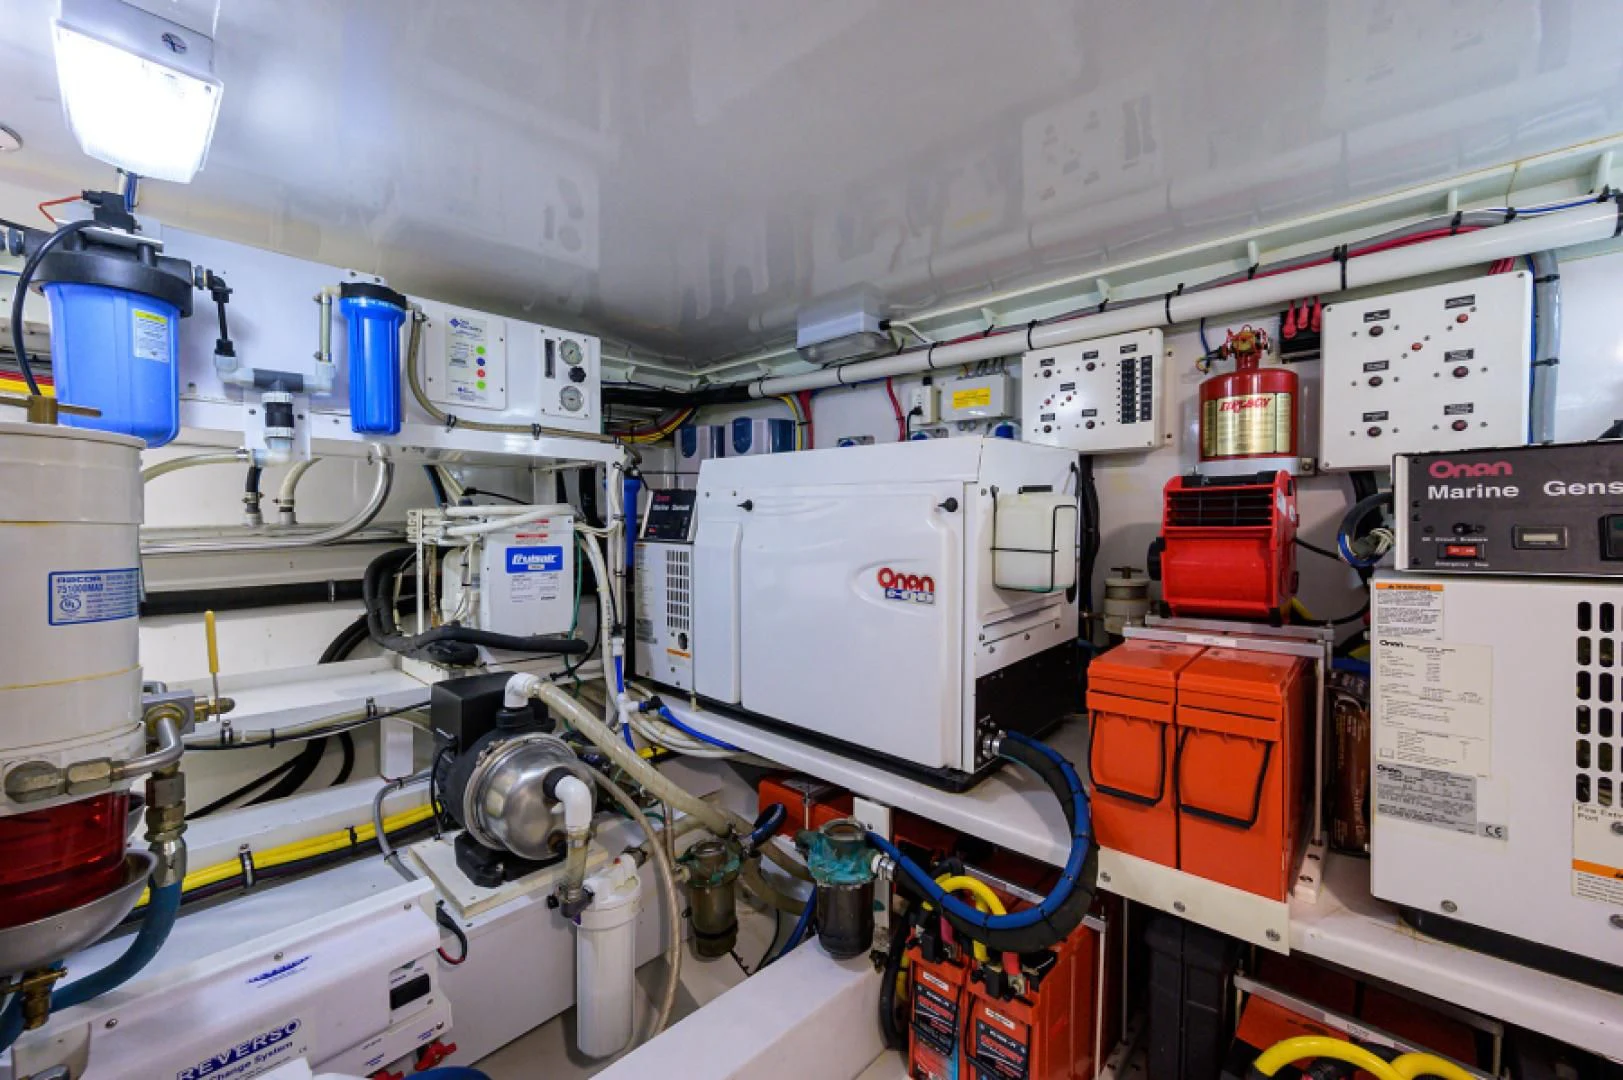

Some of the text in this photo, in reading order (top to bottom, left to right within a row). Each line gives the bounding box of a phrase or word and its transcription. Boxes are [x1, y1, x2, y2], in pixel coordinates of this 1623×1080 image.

[1429, 460, 1514, 479] Onan
[1427, 483, 1520, 500] Marine
[877, 567, 935, 593] Onan
[177, 1018, 302, 1080] REVERSO
[254, 1041, 293, 1064] System
